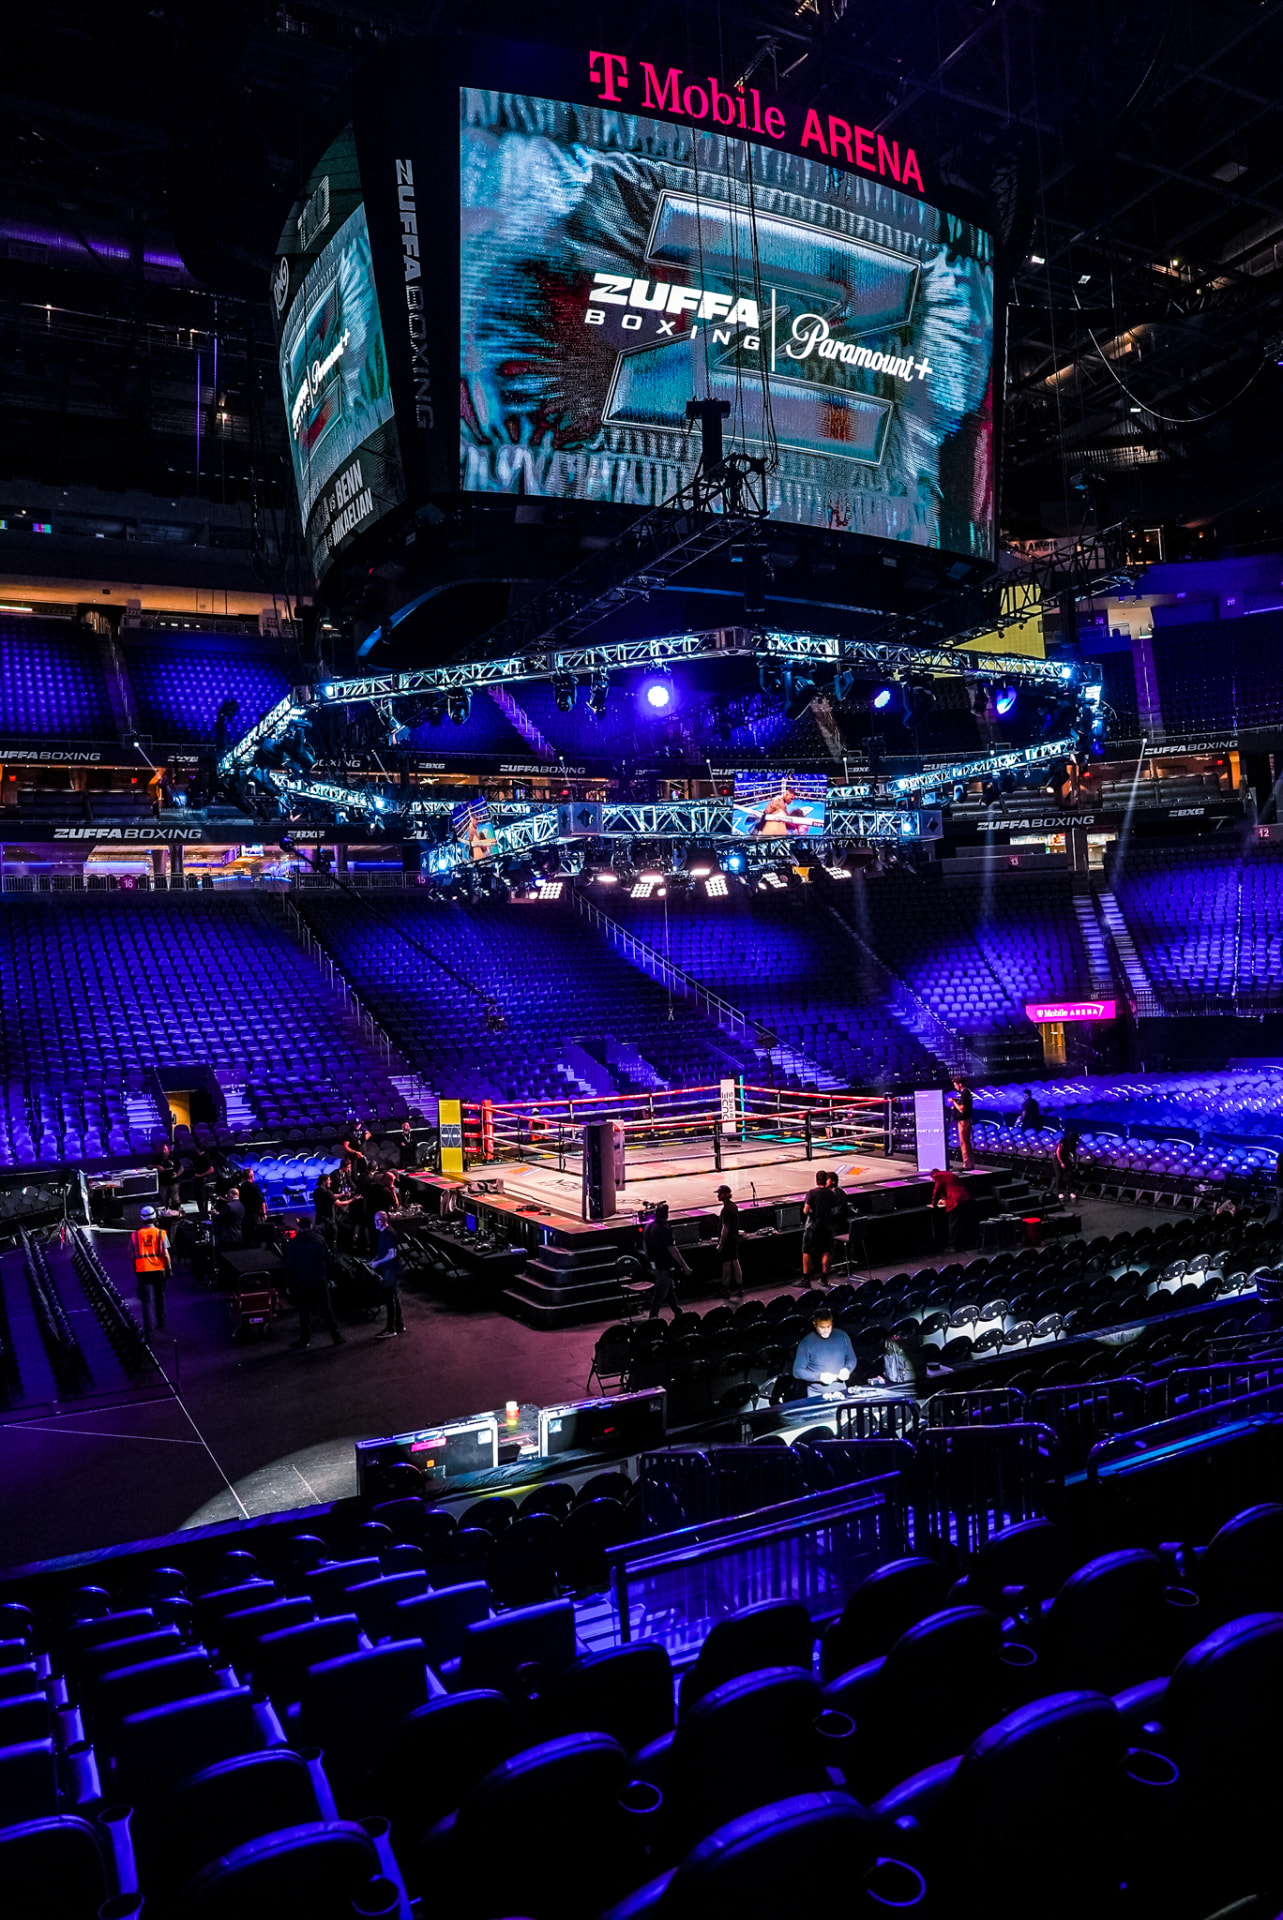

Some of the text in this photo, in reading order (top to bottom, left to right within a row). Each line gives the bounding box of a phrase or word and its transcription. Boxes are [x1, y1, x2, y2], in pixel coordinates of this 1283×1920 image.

[589, 50, 925, 193] T Mobile ARENA
[588, 272, 760, 329] ZUFFA
[584, 309, 761, 351] BOXING
[785, 313, 933, 383] Paramount+
[335, 459, 363, 510] BENN
[332, 487, 374, 546] MIKAELIAN
[1259, 829, 1270, 838] 12
[123, 878, 133, 889] 16
[1010, 857, 1019, 866] 13
[1044, 1008, 1068, 1018] Mobile
[1069, 1008, 1098, 1017] ARENA
